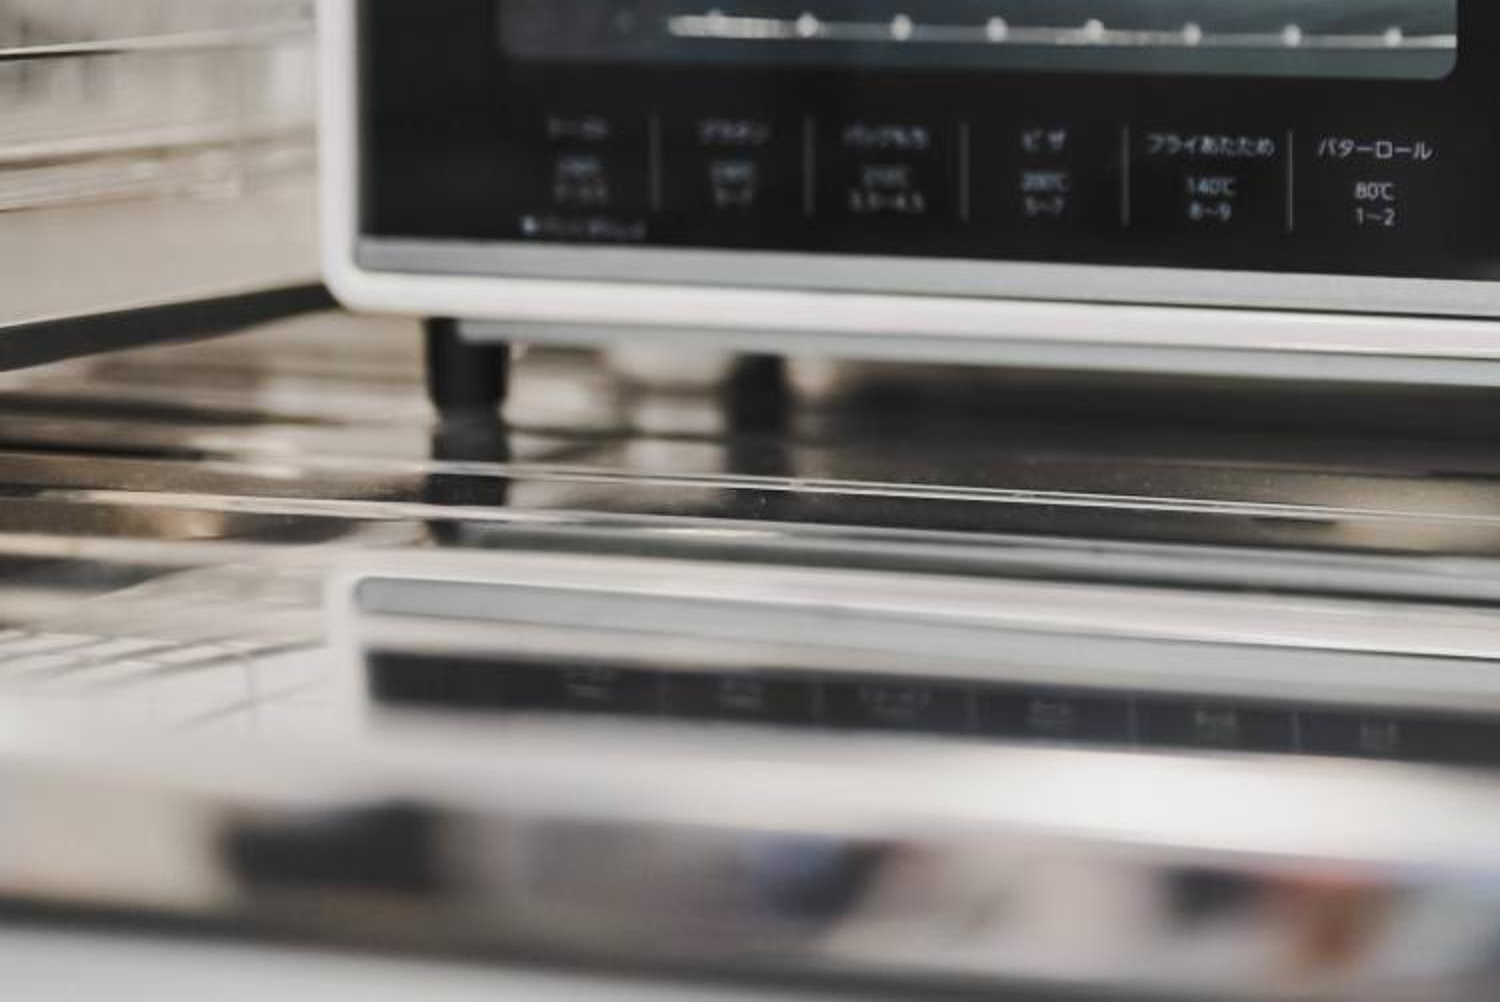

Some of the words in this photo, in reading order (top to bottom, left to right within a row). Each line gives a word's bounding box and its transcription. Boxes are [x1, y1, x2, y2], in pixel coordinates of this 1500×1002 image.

[1147, 134, 1275, 158] フライあたため
